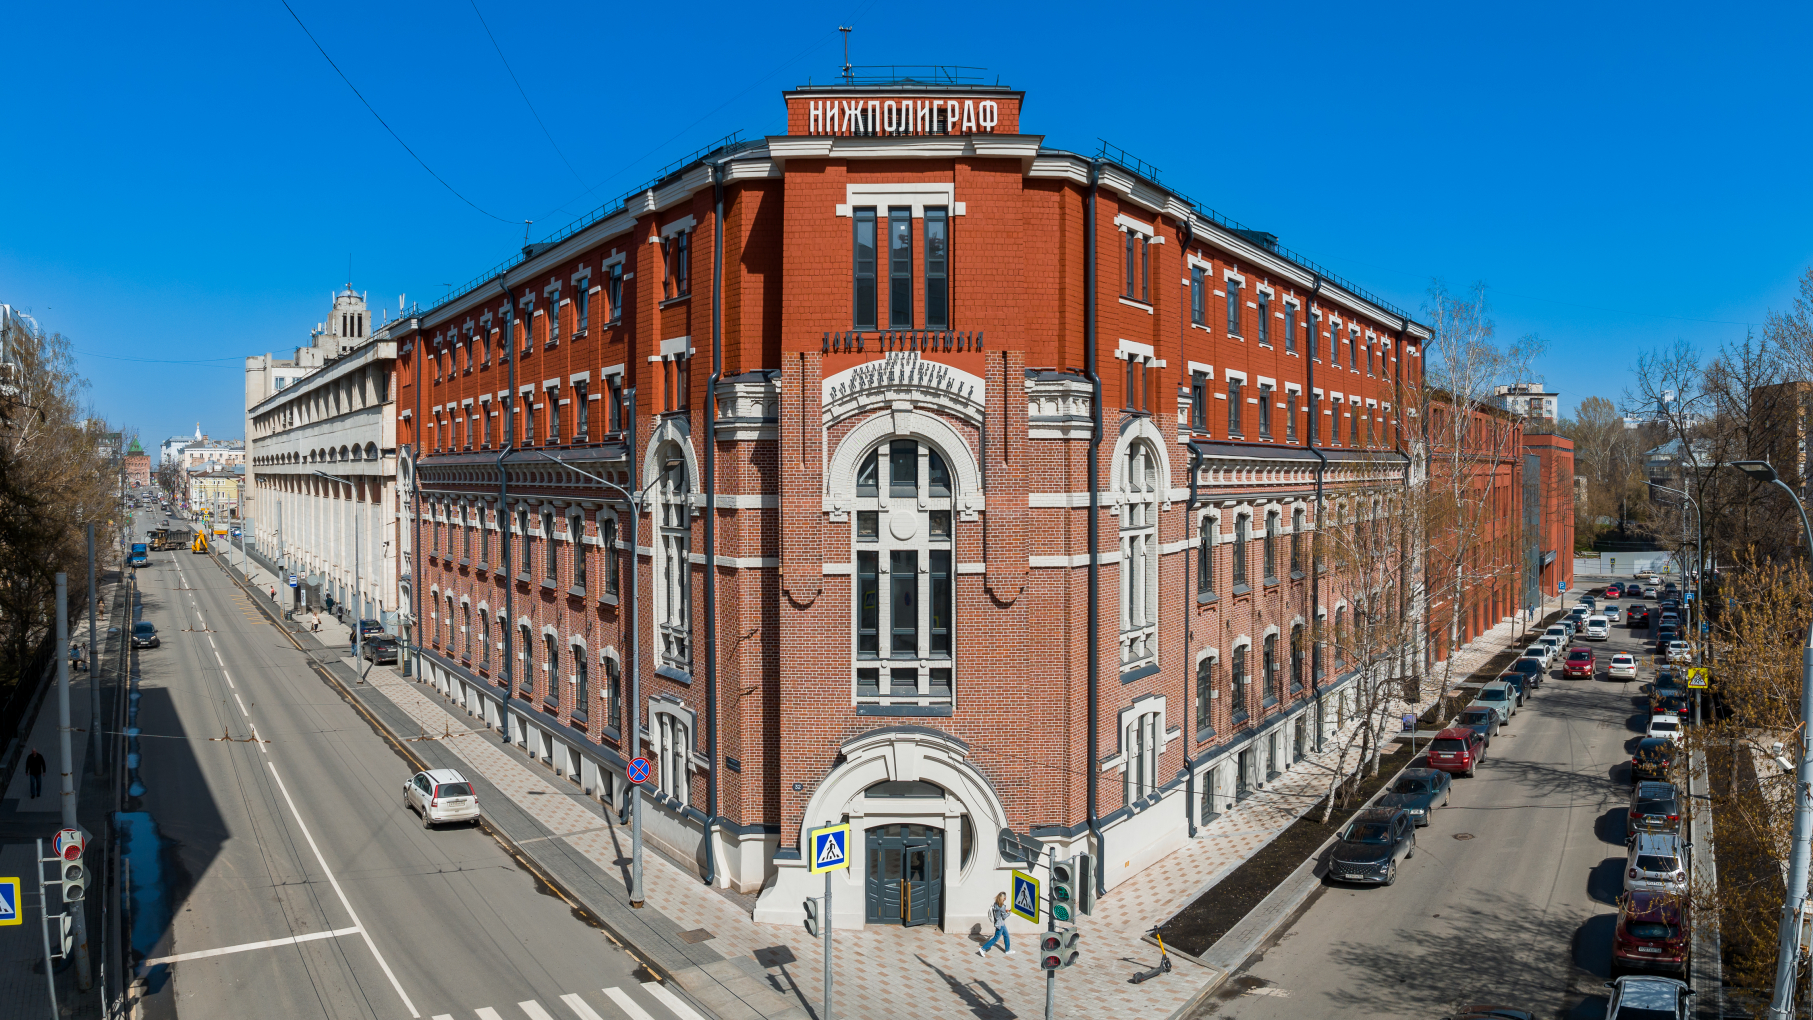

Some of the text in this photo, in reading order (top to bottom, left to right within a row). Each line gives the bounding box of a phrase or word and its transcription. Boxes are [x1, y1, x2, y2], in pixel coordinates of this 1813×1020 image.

[809, 100, 998, 132] НИЖПОЛИГРАФ
[822, 331, 984, 350] ДОМЪ ТРУДОЛЮБІЯ
